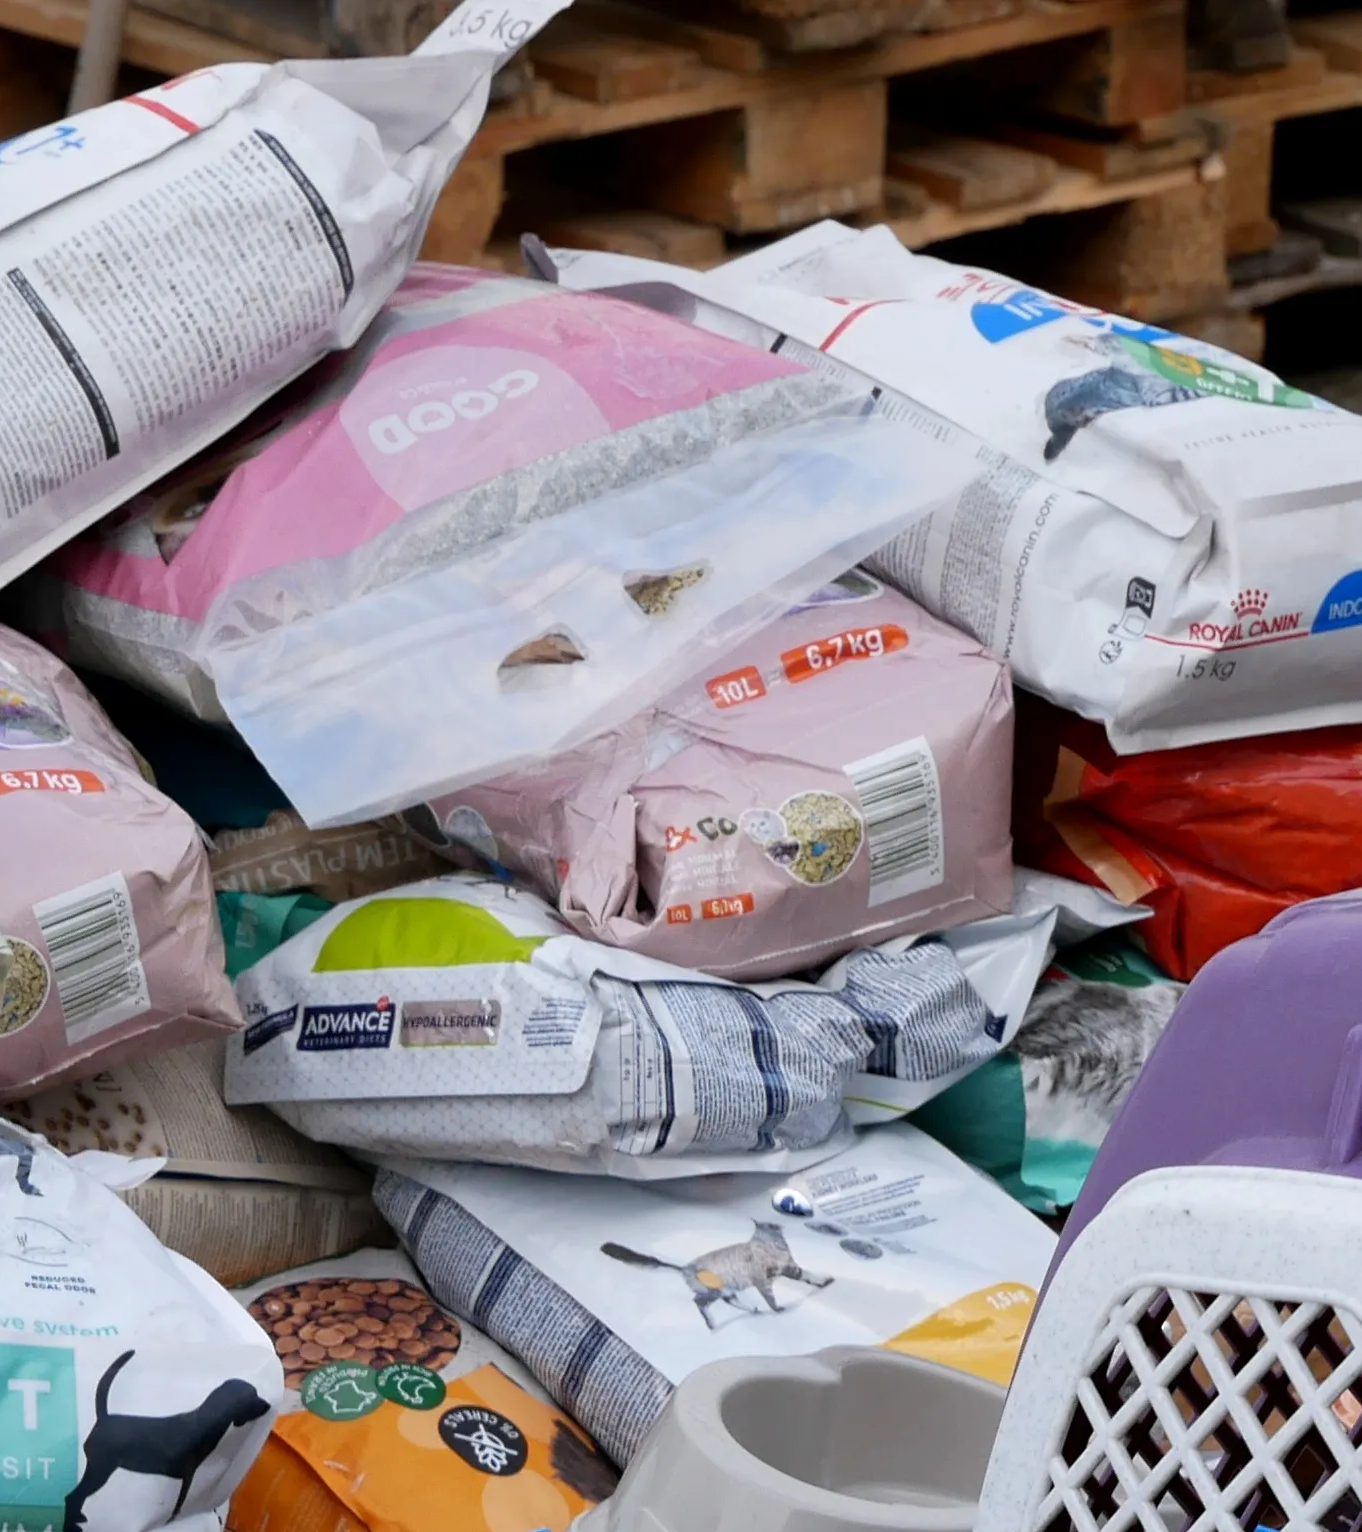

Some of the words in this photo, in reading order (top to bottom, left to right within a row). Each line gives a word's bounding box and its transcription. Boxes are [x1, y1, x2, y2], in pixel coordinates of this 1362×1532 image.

[490, 9, 533, 49] kg
[369, 368, 539, 454] GOOD
[1003, 491, 1060, 661] www.royalcanin.com
[1189, 621, 1245, 643] ROYAL
[1249, 611, 1300, 637] CANIN
[717, 676, 759, 705] 10L
[847, 628, 884, 657] kg
[1175, 655, 1207, 680] 1.5
[1210, 656, 1237, 682] kg
[42, 771, 82, 795] kg
[305, 1011, 391, 1034] ADVANCE
[31, 1273, 86, 1285] REDUCED
[443, 1409, 499, 1429] CEREALS
[498, 1422, 520, 1440] 0%
